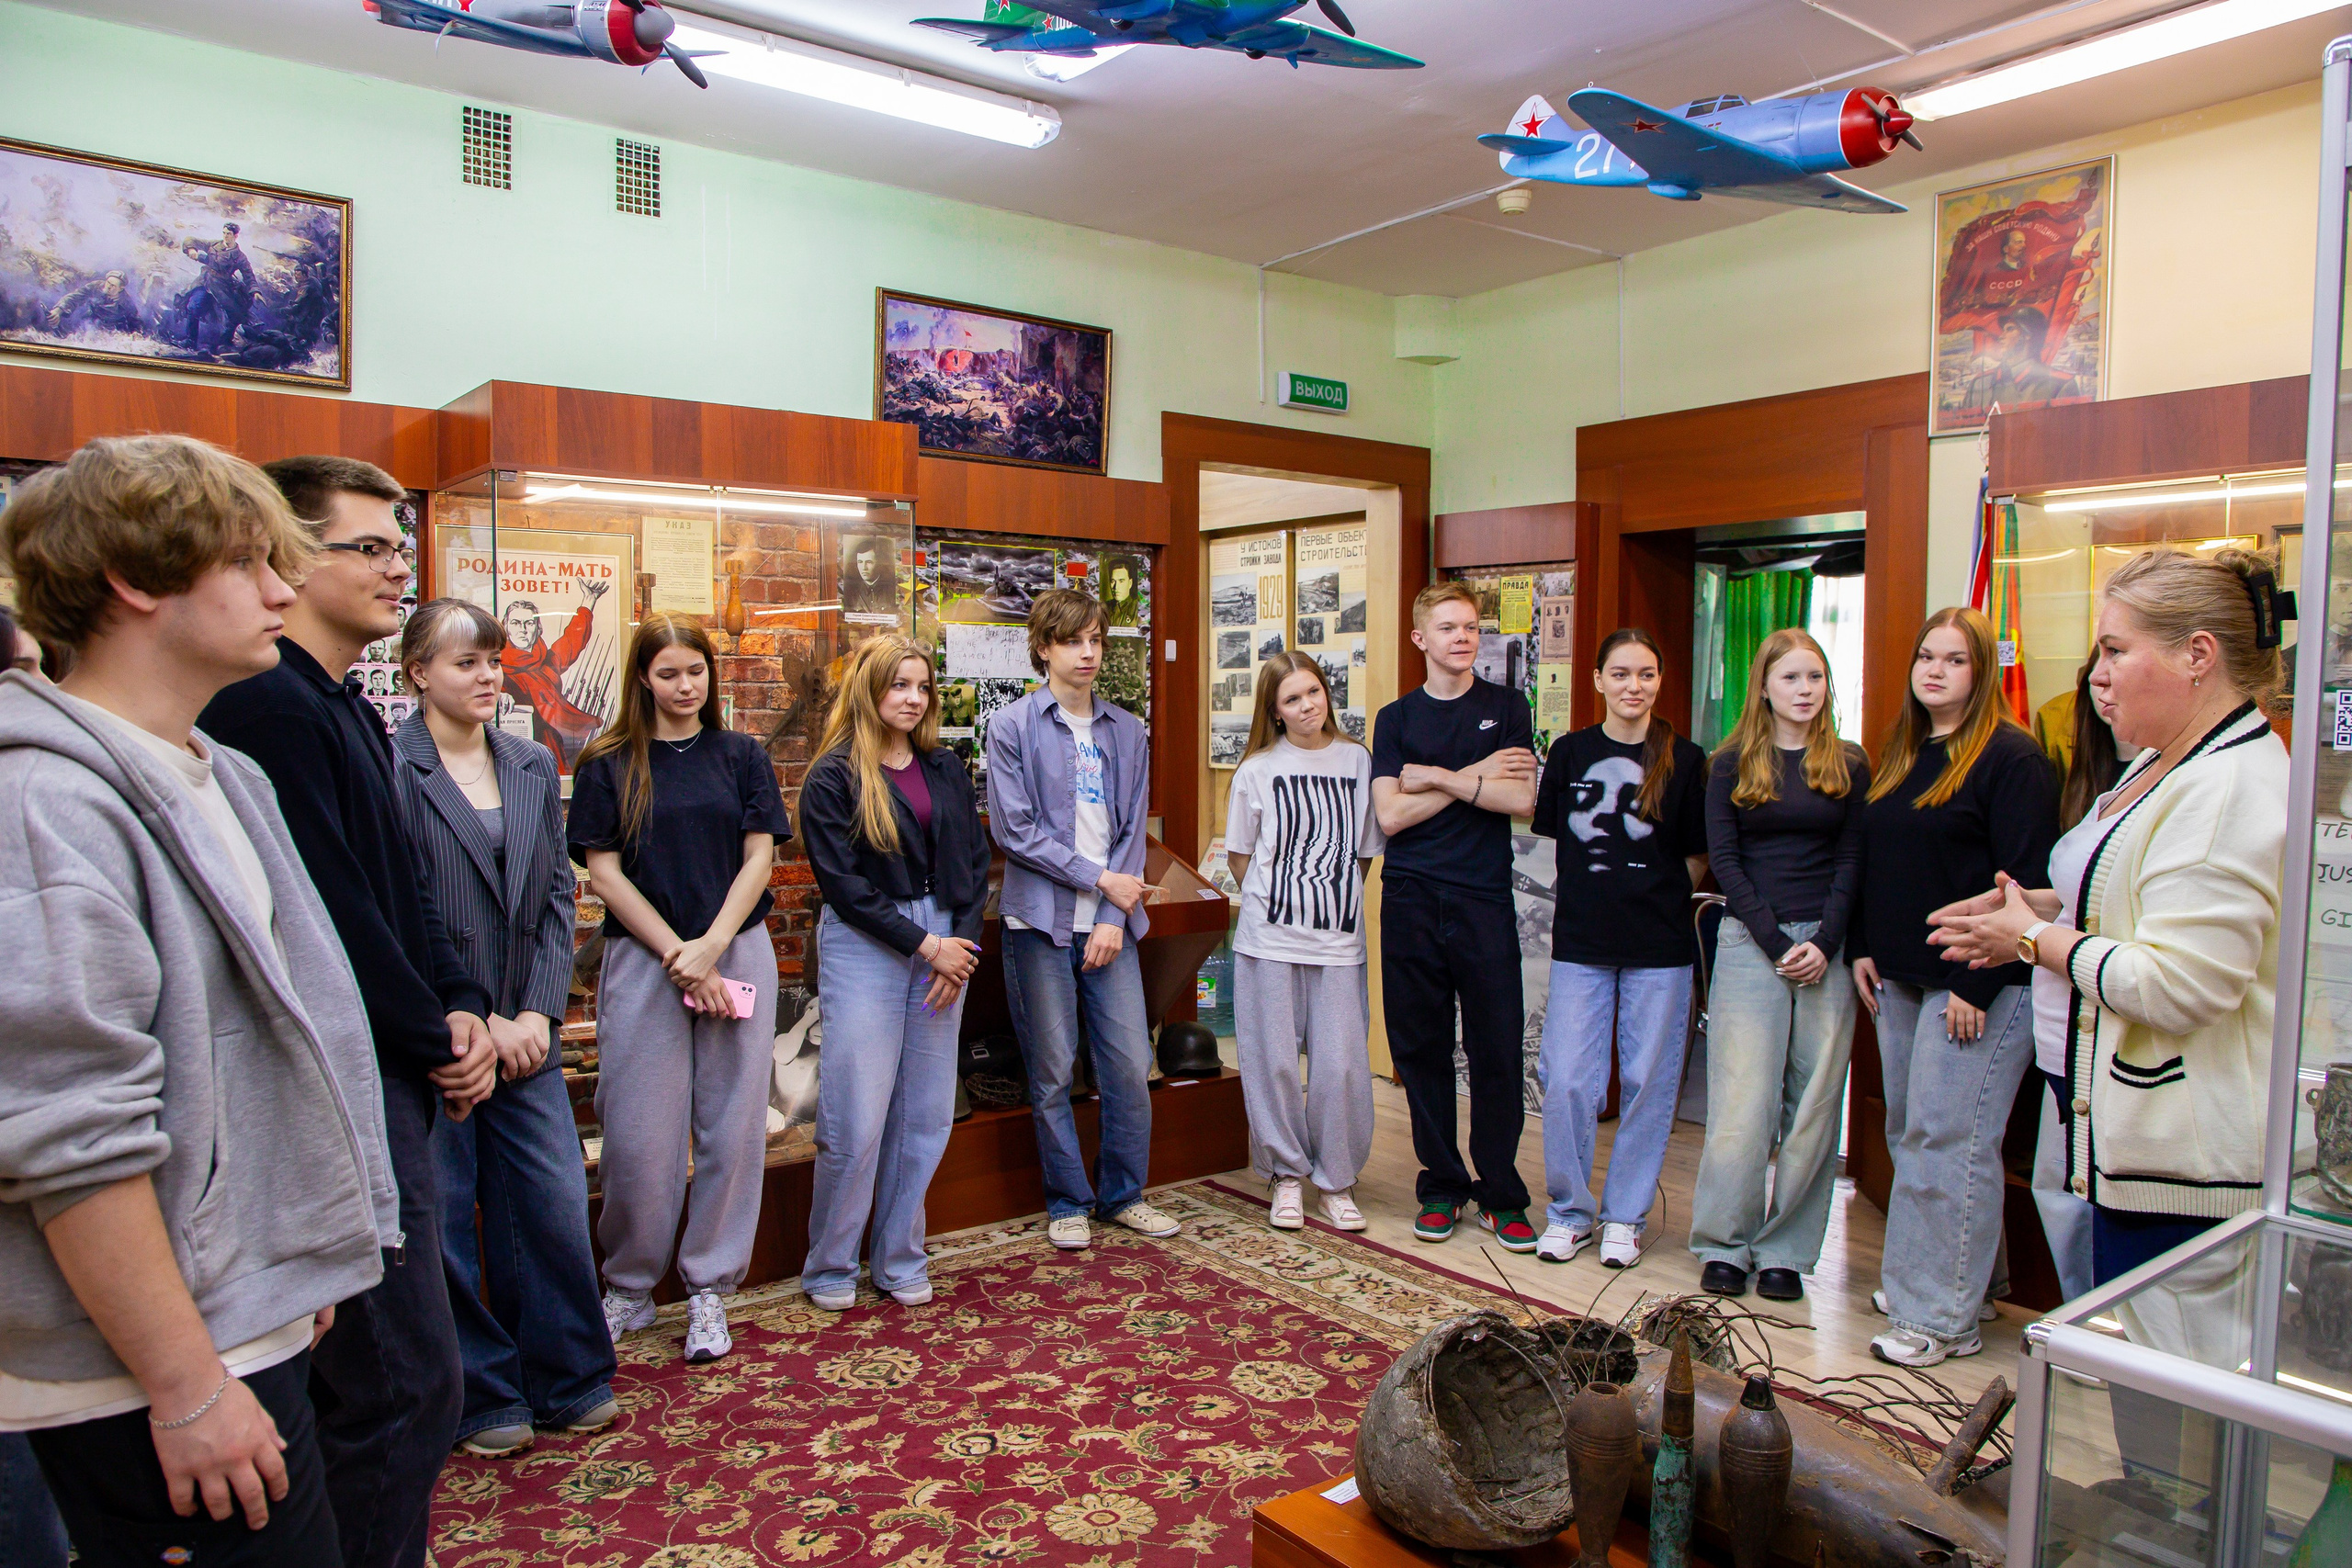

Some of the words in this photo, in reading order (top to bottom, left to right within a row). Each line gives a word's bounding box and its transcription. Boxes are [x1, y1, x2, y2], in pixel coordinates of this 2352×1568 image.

[1989, 279, 2023, 290] СССР
[1295, 380, 1343, 405] ВЫХОД
[665, 520, 692, 530] УКАЗ
[1240, 542, 1246, 553] У
[1248, 538, 1283, 552] ИСТОКОВ
[1300, 533, 1333, 547] ПЕРВЫЕ
[1240, 553, 1261, 567] СТРОЙКИ
[1263, 553, 1282, 566] ЗАВОДА
[457, 557, 613, 579] РОДИНА-МАТЬ
[500, 578, 570, 594] ЗОВЕТ!
[1502, 581, 1529, 591] ПРАВДА
[1258, 574, 1283, 620] 1929
